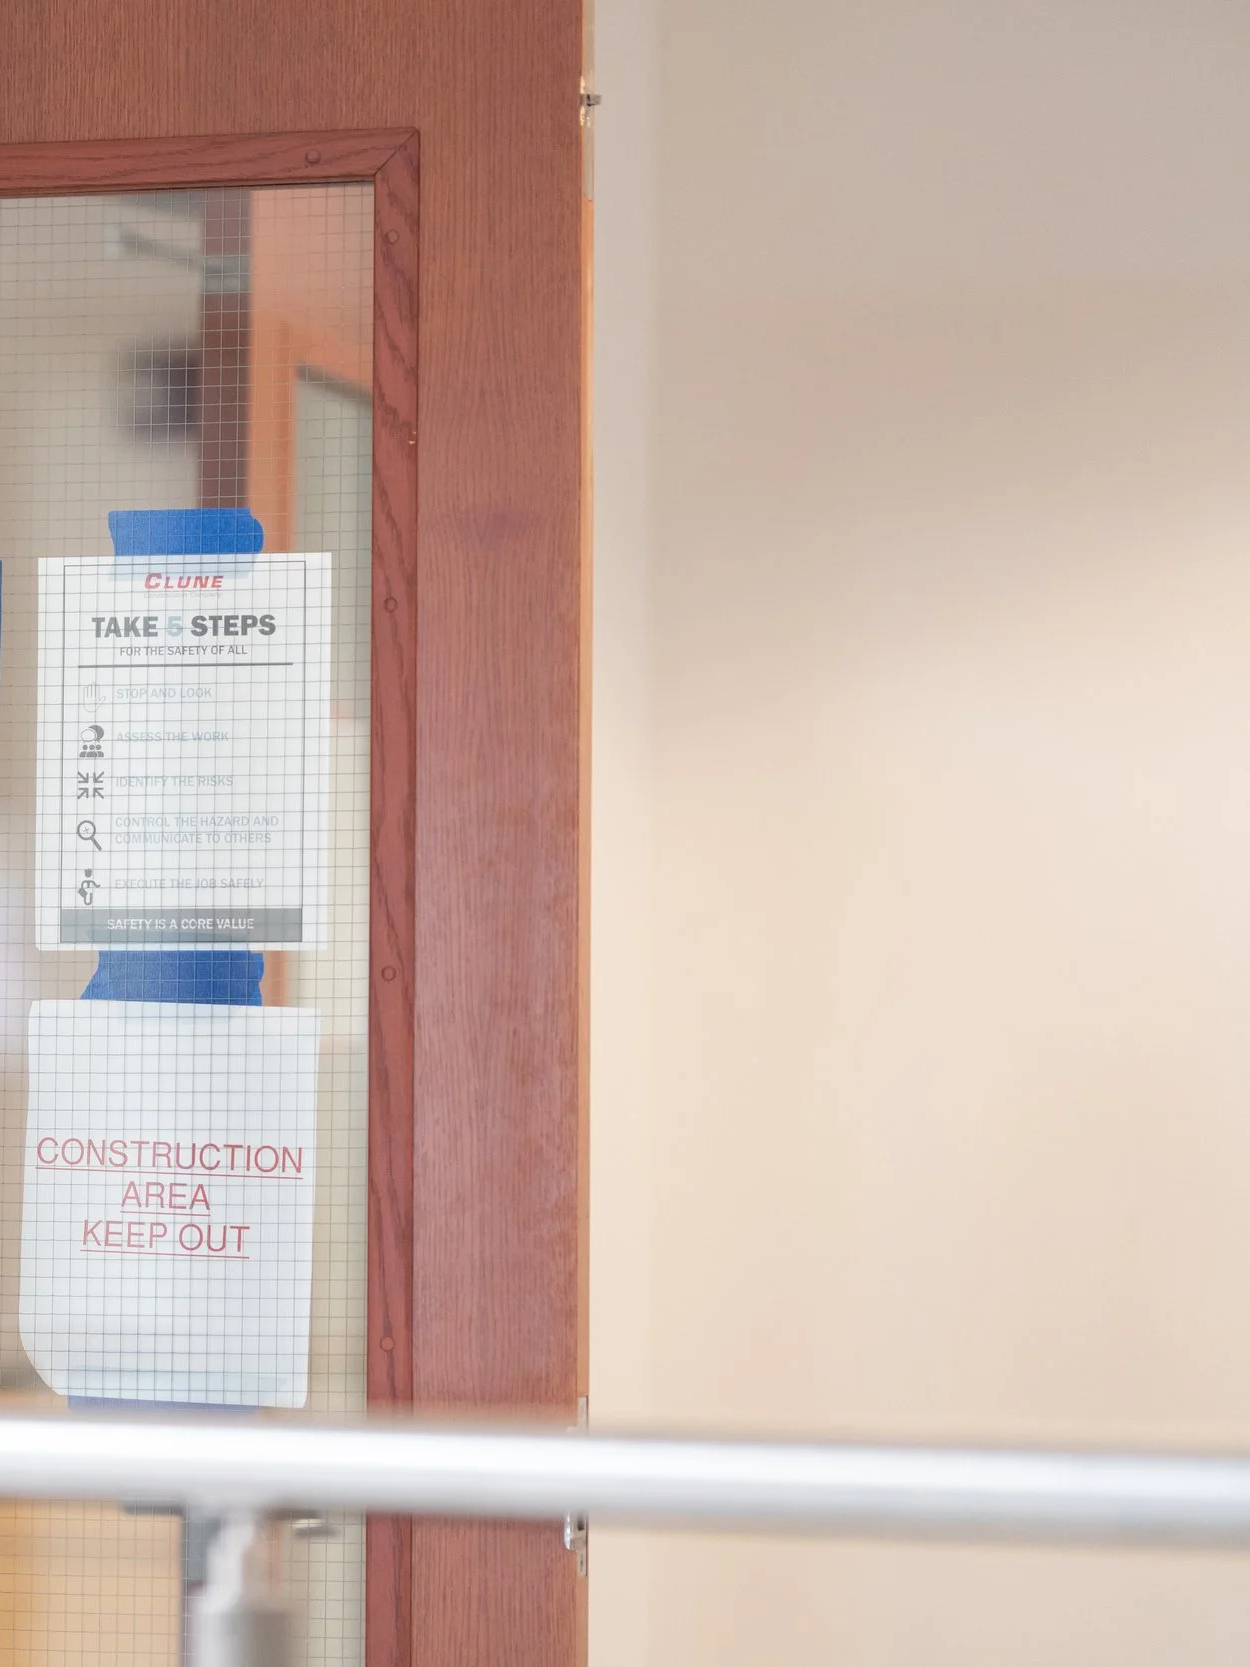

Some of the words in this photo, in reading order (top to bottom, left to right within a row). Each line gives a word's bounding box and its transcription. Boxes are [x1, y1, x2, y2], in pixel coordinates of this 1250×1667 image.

[144, 572, 224, 590] CLUNE
[91, 616, 159, 638] TAKE
[166, 615, 182, 637] 5
[190, 614, 276, 636] STEPS
[119, 646, 141, 656] FOR
[144, 646, 164, 656] THE
[167, 645, 208, 656] SAFETY
[210, 645, 225, 655] OF
[227, 644, 248, 655] ALL
[116, 687, 147, 699] STOP
[150, 687, 176, 699] AND
[180, 687, 213, 698] LOOK
[116, 731, 162, 742] ASSESS
[166, 731, 189, 741] THE
[191, 731, 229, 741] WORK
[115, 776, 168, 787] IDENTIFY
[171, 776, 195, 787] THE
[198, 775, 234, 786] RISKS
[115, 816, 171, 828] CONTROL
[174, 816, 197, 827] THE
[200, 816, 250, 827] HAZARD
[253, 815, 279, 826] AND
[115, 833, 202, 845] COMMUNICATE
[206, 833, 221, 844] TO
[224, 832, 271, 844] OTHERS
[115, 878, 166, 889] EXECUTE
[169, 878, 192, 889] THE
[195, 878, 218, 889] JOB
[221, 878, 264, 889] SAFELY
[107, 919, 152, 930] SAFETY
[155, 919, 167, 930] IS
[169, 919, 178, 930] A
[181, 918, 214, 930] CORE
[216, 918, 254, 930] VALUE
[36, 1136, 303, 1174] CONSTRUCTION
[121, 1181, 211, 1211] AREA
[82, 1219, 168, 1249] KEEP
[178, 1223, 250, 1253] OUT
